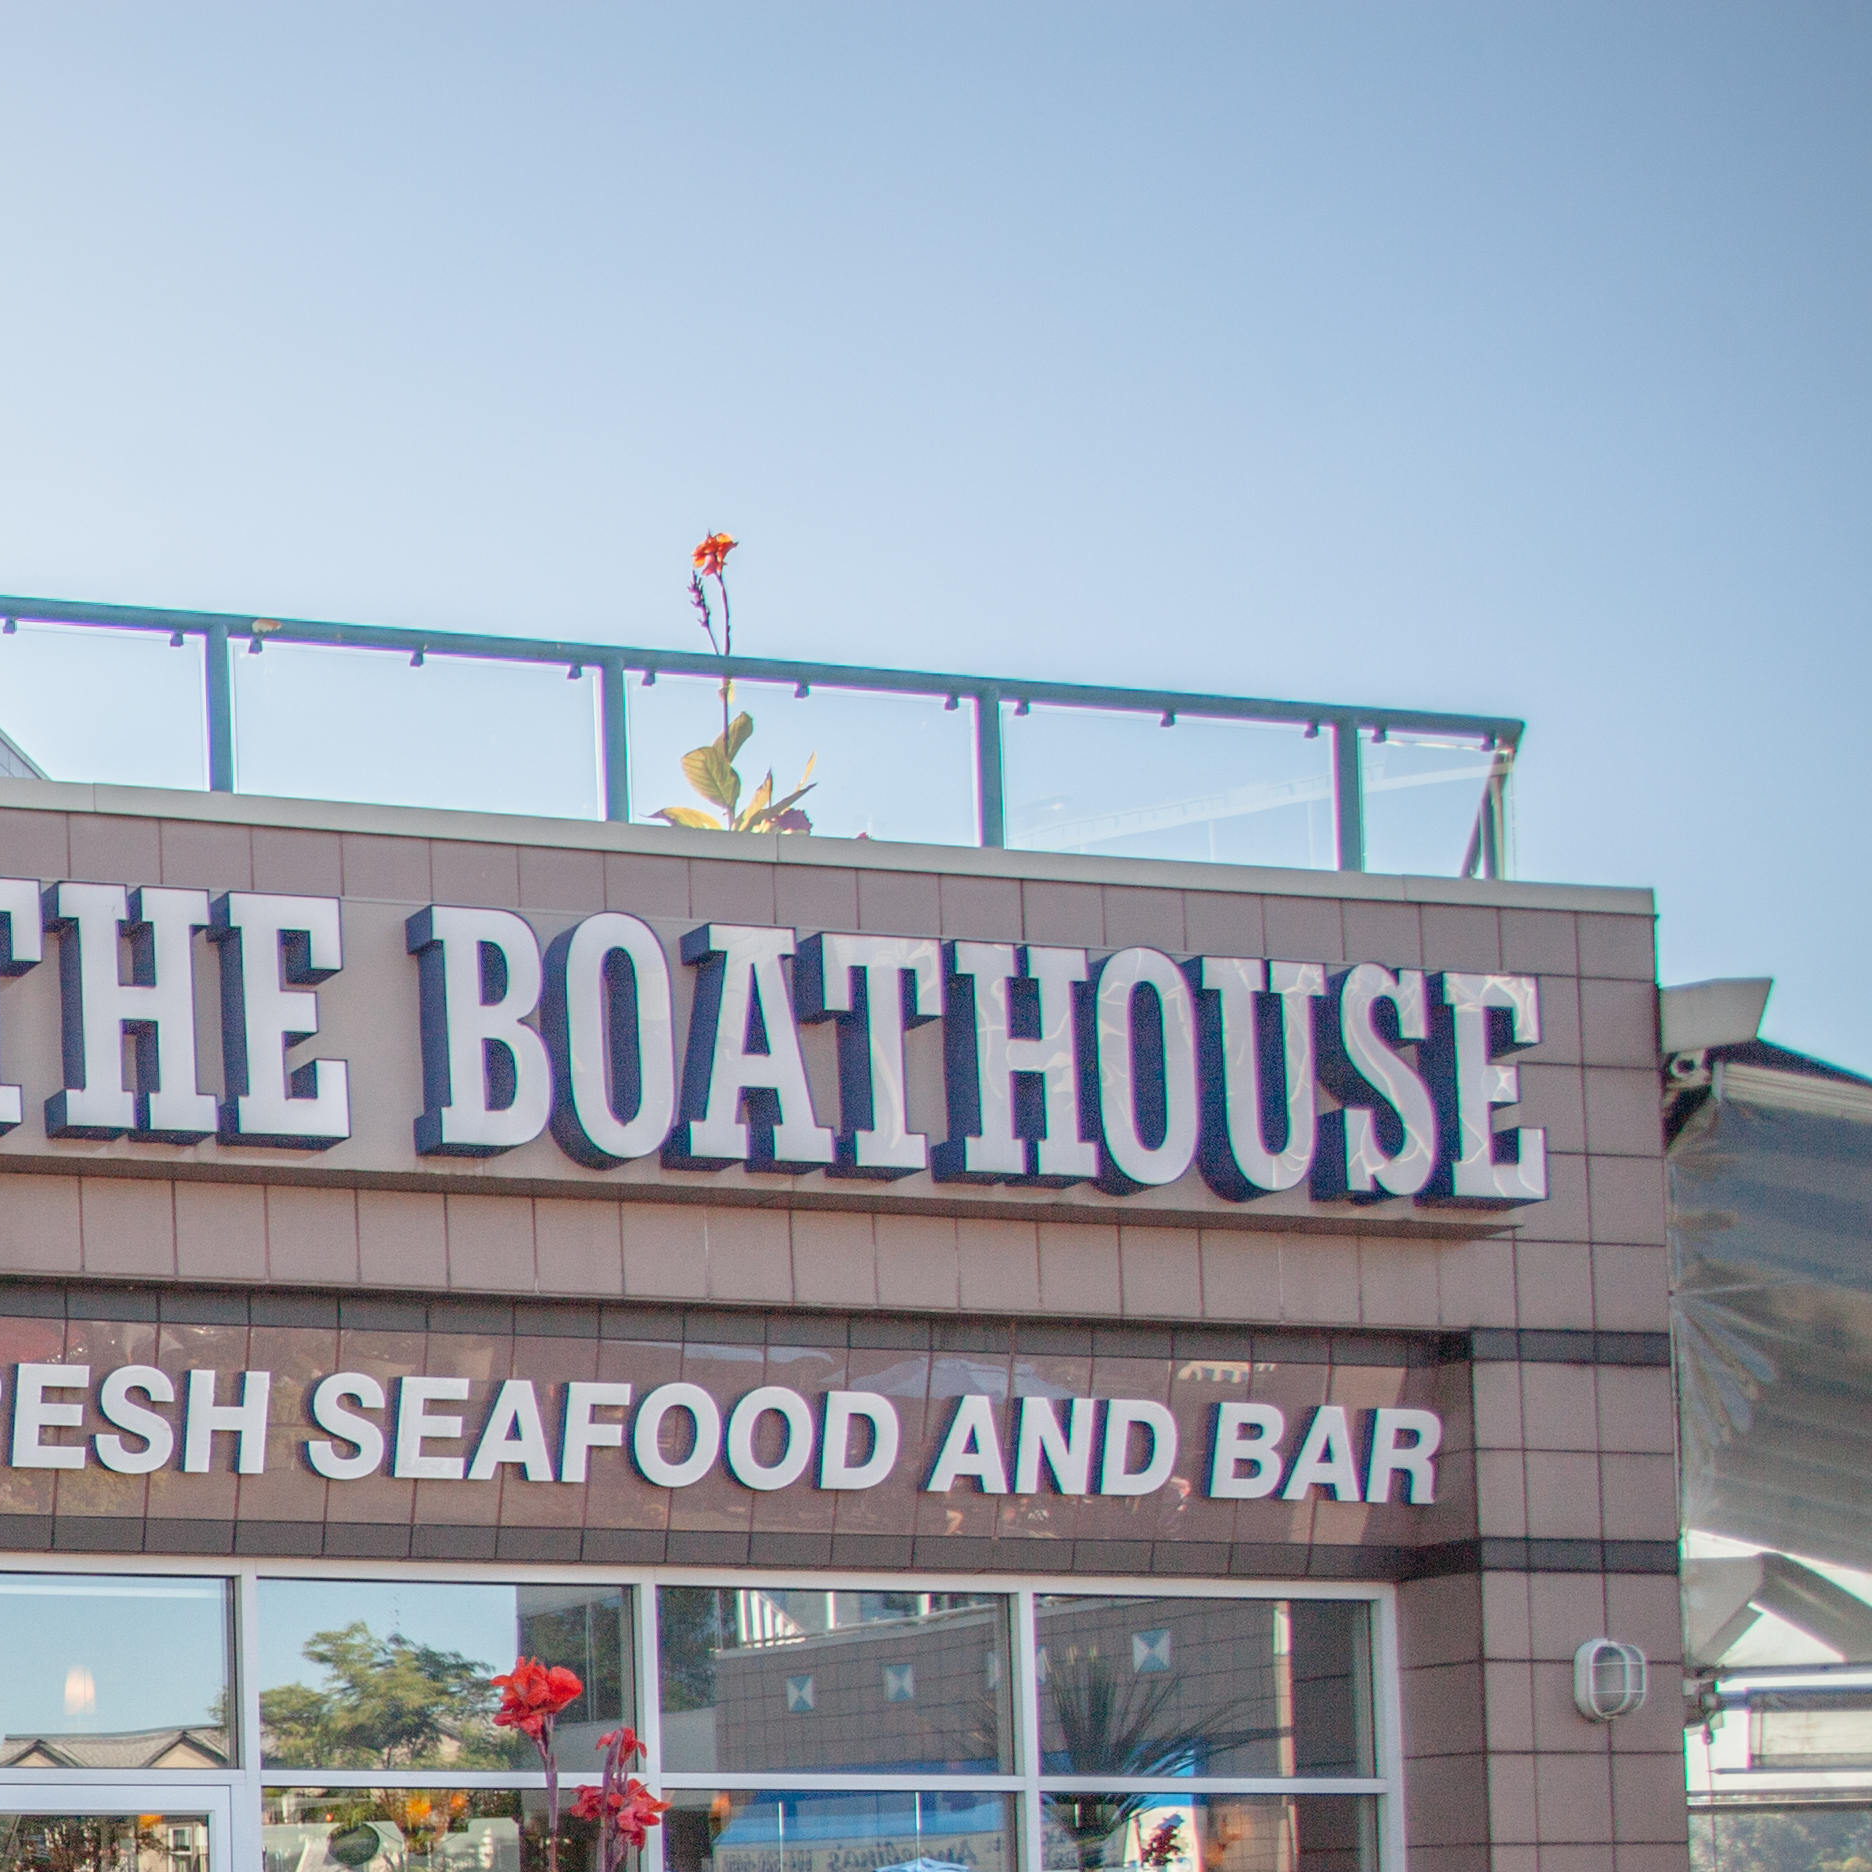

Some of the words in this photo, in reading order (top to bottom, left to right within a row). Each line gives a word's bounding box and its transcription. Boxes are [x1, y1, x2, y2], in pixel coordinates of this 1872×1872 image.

[406, 904, 1550, 1206] BOATHOUSE
[305, 1370, 902, 1491] SEAFOOD
[926, 1396, 1180, 1500] AND
[1209, 1401, 1446, 1505] BAR
